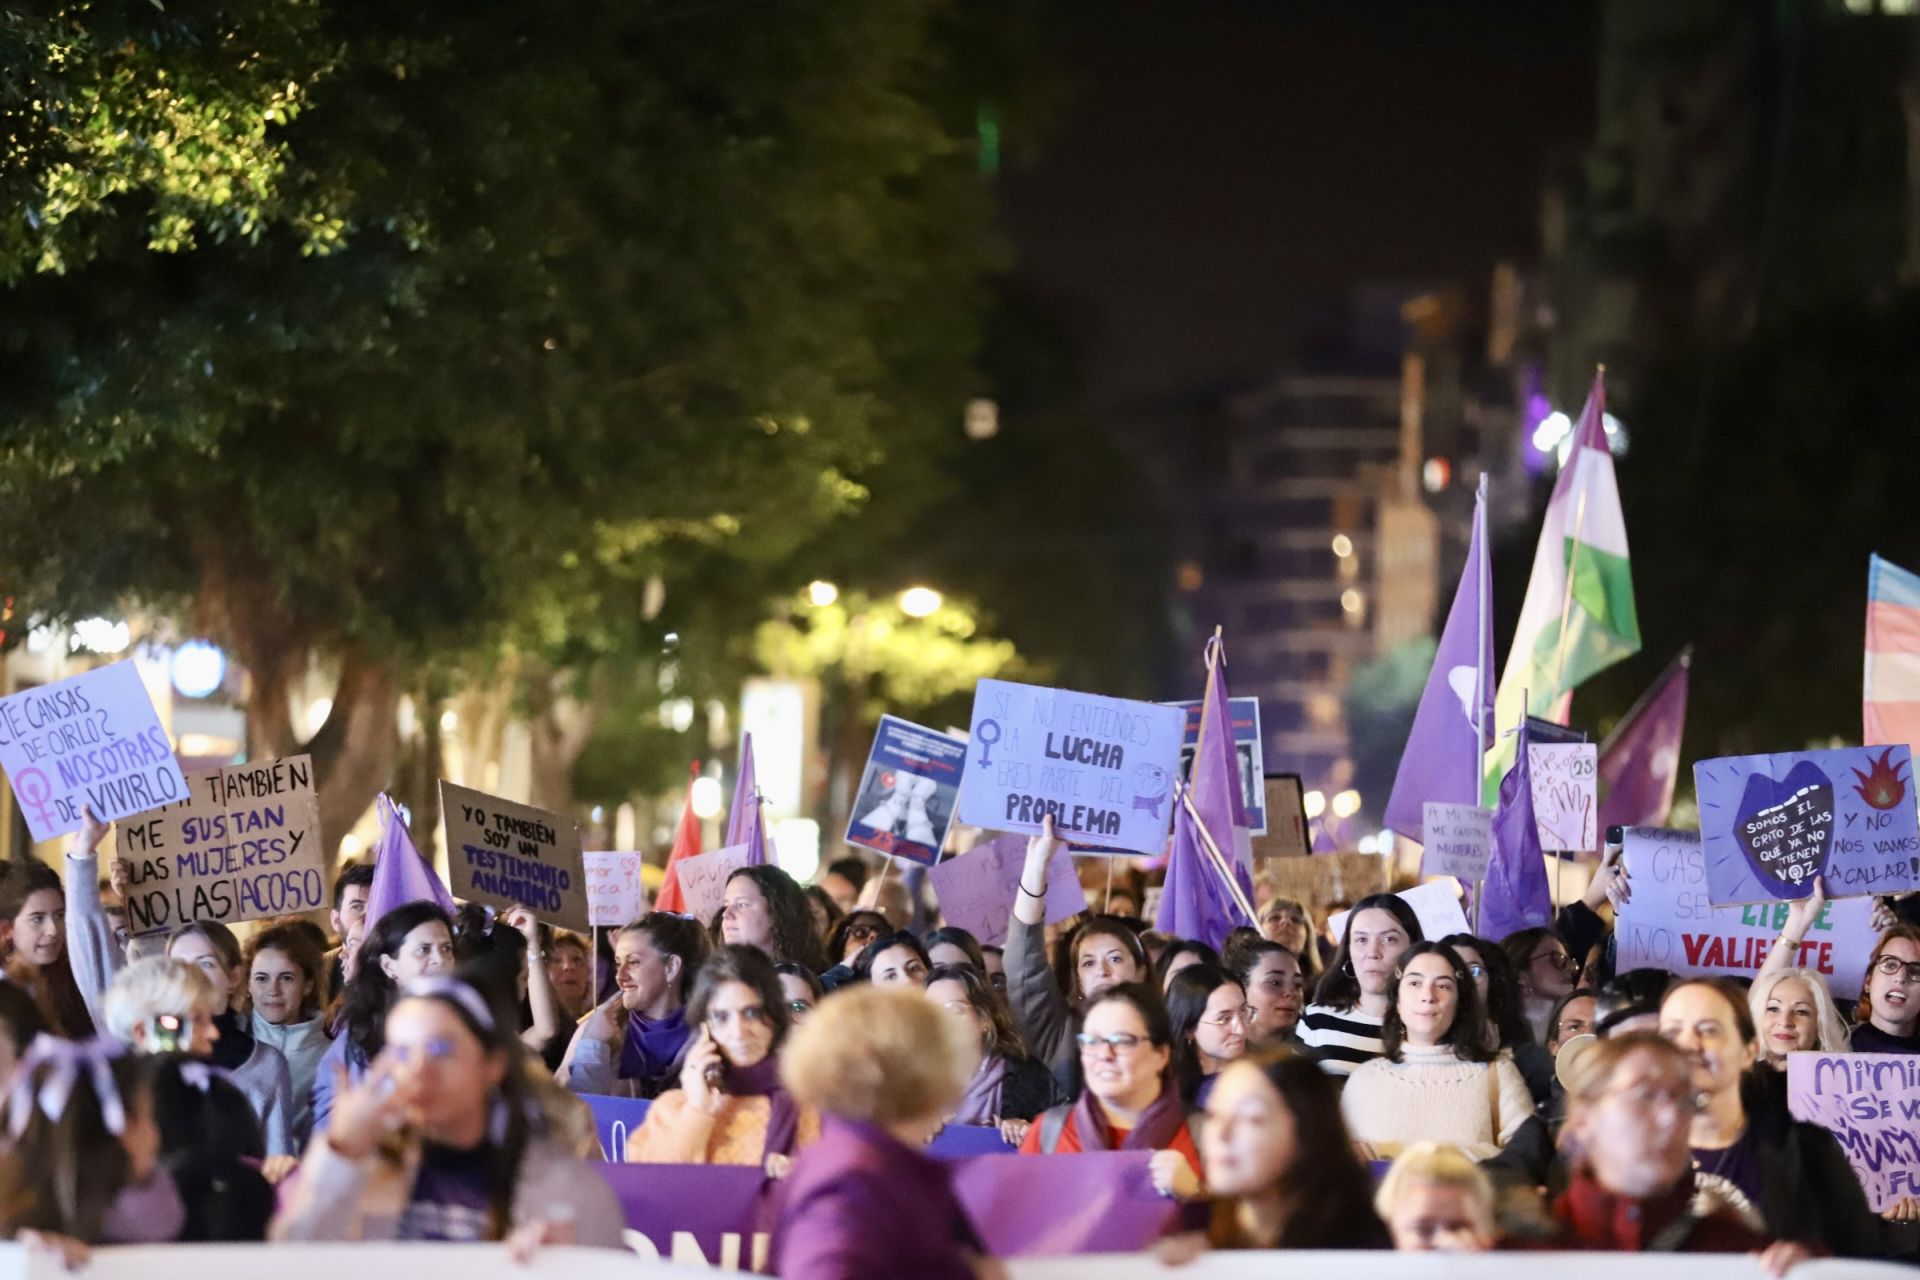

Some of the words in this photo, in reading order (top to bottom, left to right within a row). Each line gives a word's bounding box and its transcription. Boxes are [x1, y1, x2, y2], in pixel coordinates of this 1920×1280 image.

[24, 685, 90, 729] CANSAS
[992, 691, 1012, 720] SI
[1032, 696, 1057, 728] NO
[1069, 703, 1152, 747] ENTIENDES
[21, 736, 47, 763] DE
[47, 708, 116, 755] OIRLO?
[1003, 727, 1020, 752] LA
[1044, 732, 1124, 770] LUCHA
[56, 725, 170, 790] NOSOTRAS
[55, 795, 82, 823] DE
[86, 765, 177, 818] VIVIRLO
[205, 758, 309, 803] TAMBIÉN
[996, 759, 1032, 790] ERES
[1040, 764, 1085, 797] PARTE
[1099, 775, 1126, 805] DEL
[127, 819, 165, 851] ME
[461, 803, 486, 826] YO
[492, 814, 557, 847] TAMBIÉN
[1005, 793, 1122, 836] PROBLEMA
[1746, 814, 1788, 834] SOMOS
[1796, 800, 1816, 816] EL
[1789, 823, 1806, 837] DE
[1810, 811, 1833, 826] LAS
[1843, 812, 1859, 829] Y
[1866, 811, 1893, 831] NO
[128, 856, 170, 885] LAS
[176, 838, 286, 879] MUJERES
[288, 829, 305, 855] Y
[484, 828, 511, 849] SOY
[518, 840, 540, 858] UN
[1759, 845, 1783, 862] QUE
[1788, 838, 1803, 851] YA
[1807, 829, 1826, 844] NO
[1779, 845, 1820, 866] TIENEN
[1834, 838, 1865, 854] NOS
[1873, 836, 1919, 855] VAMOS
[462, 844, 571, 891] TESTIMONIO
[1775, 861, 1818, 883] VOZ
[128, 890, 171, 931] NO
[176, 879, 232, 924] LAS
[239, 868, 323, 913] ACOSO
[1741, 901, 1833, 931] LIBE
[1634, 927, 1671, 963] NO
[1681, 933, 1834, 975] VALIETE
[1850, 1096, 1892, 1120] SE
